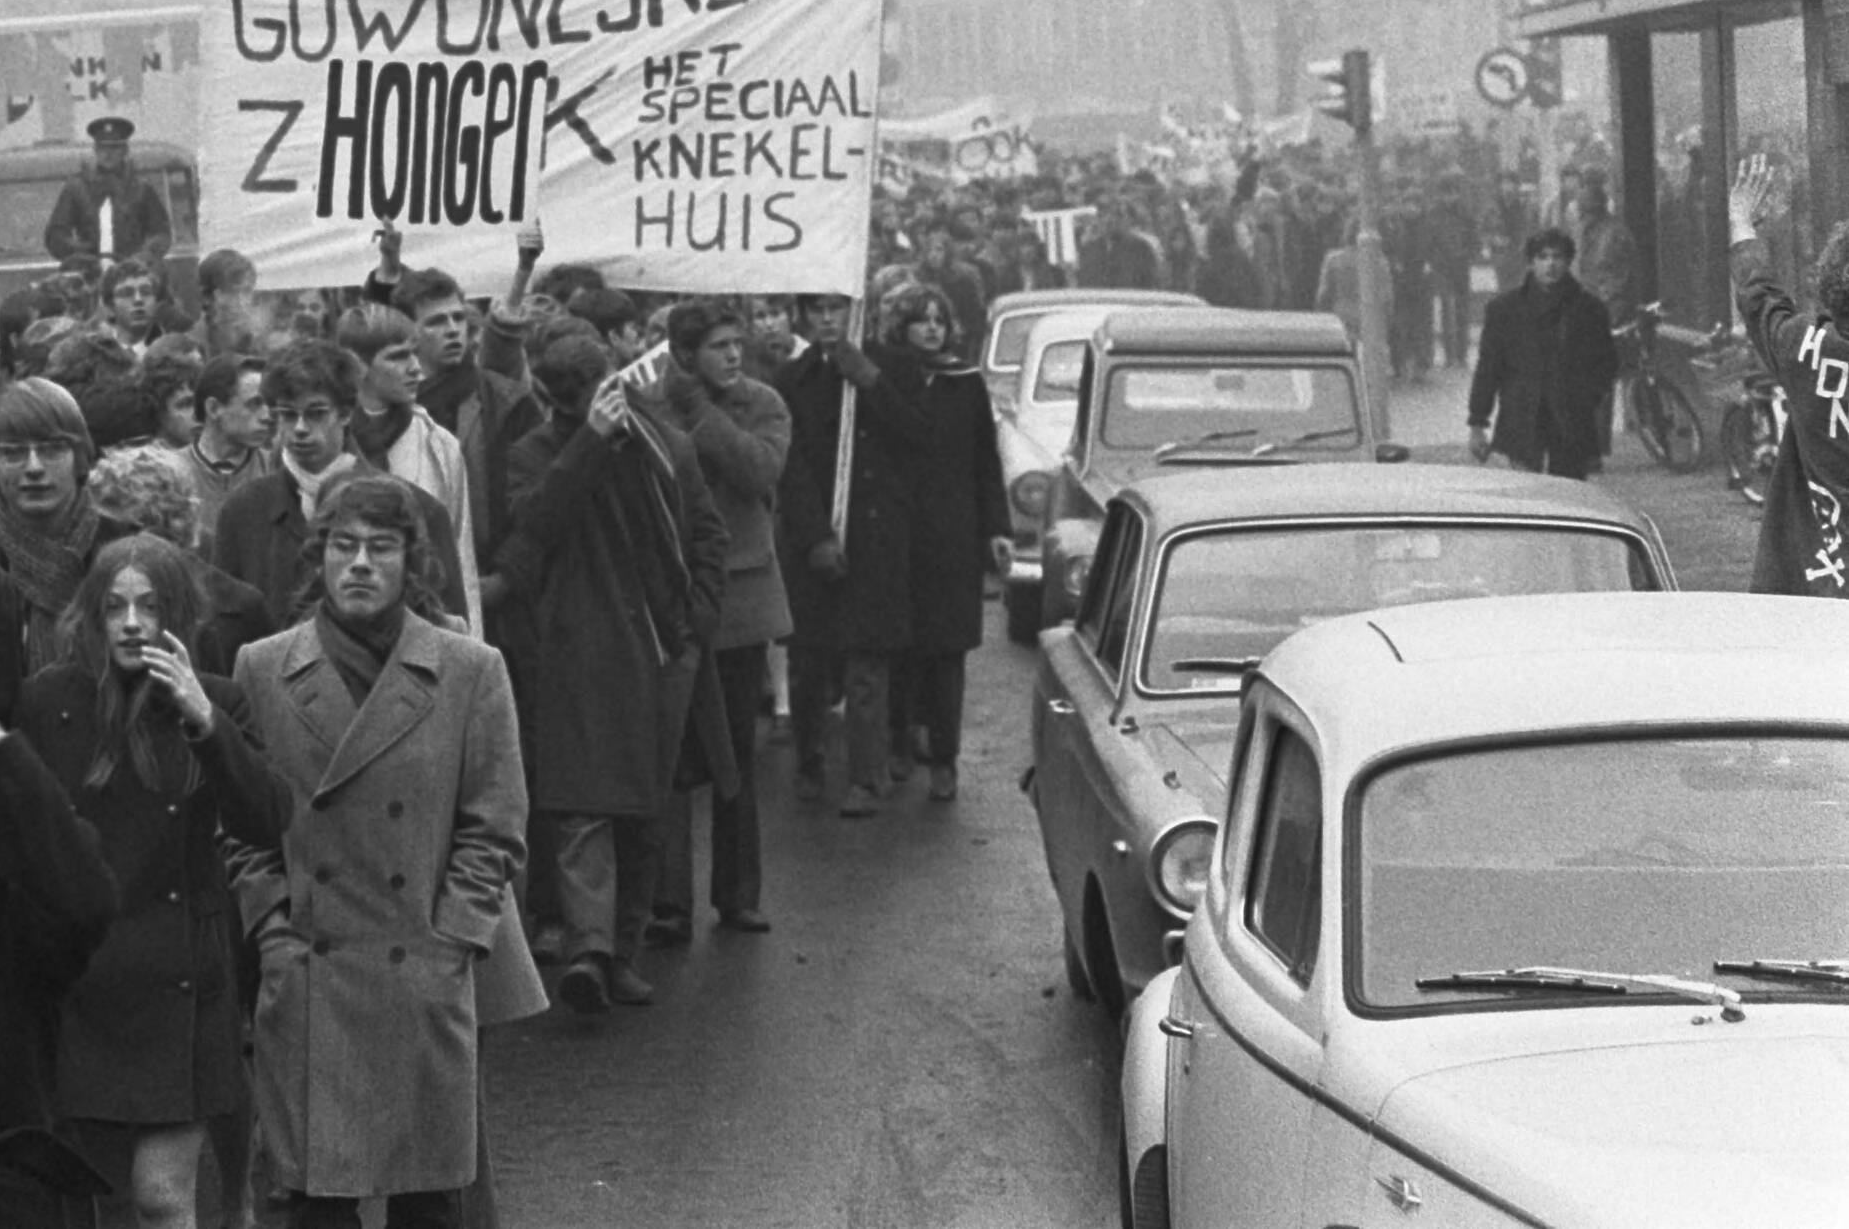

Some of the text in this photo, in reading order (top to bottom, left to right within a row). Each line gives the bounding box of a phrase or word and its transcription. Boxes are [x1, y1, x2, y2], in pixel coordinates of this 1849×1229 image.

[643, 42, 742, 89] HET
[638, 70, 872, 124] SPECIAAL
[633, 123, 864, 182] KNEKEL-
[636, 189, 802, 252] HUIS
